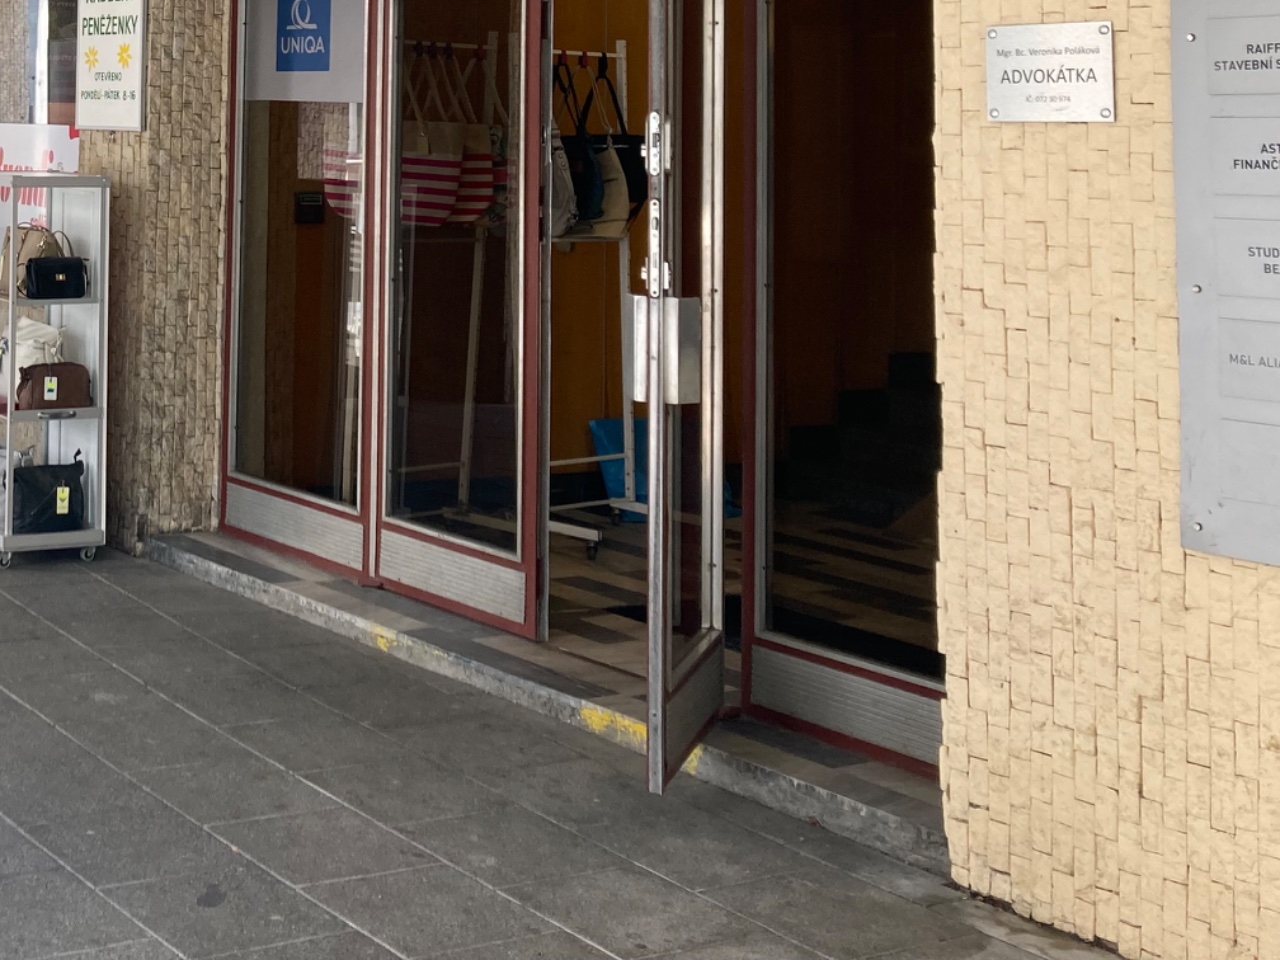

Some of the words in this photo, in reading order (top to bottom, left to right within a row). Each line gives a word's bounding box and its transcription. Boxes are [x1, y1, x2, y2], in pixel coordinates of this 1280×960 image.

[81, 13, 138, 37] PENĚŽENKY
[280, 35, 325, 54] UNIQA
[1028, 47, 1062, 57] Veronika
[1064, 46, 1100, 55] Poláková
[1214, 56, 1273, 71] STAVEBNÍ
[94, 70, 122, 82] OTEVŘENO
[1000, 64, 1098, 84] ADVOKÁTKA
[1229, 354, 1255, 366] M&L
